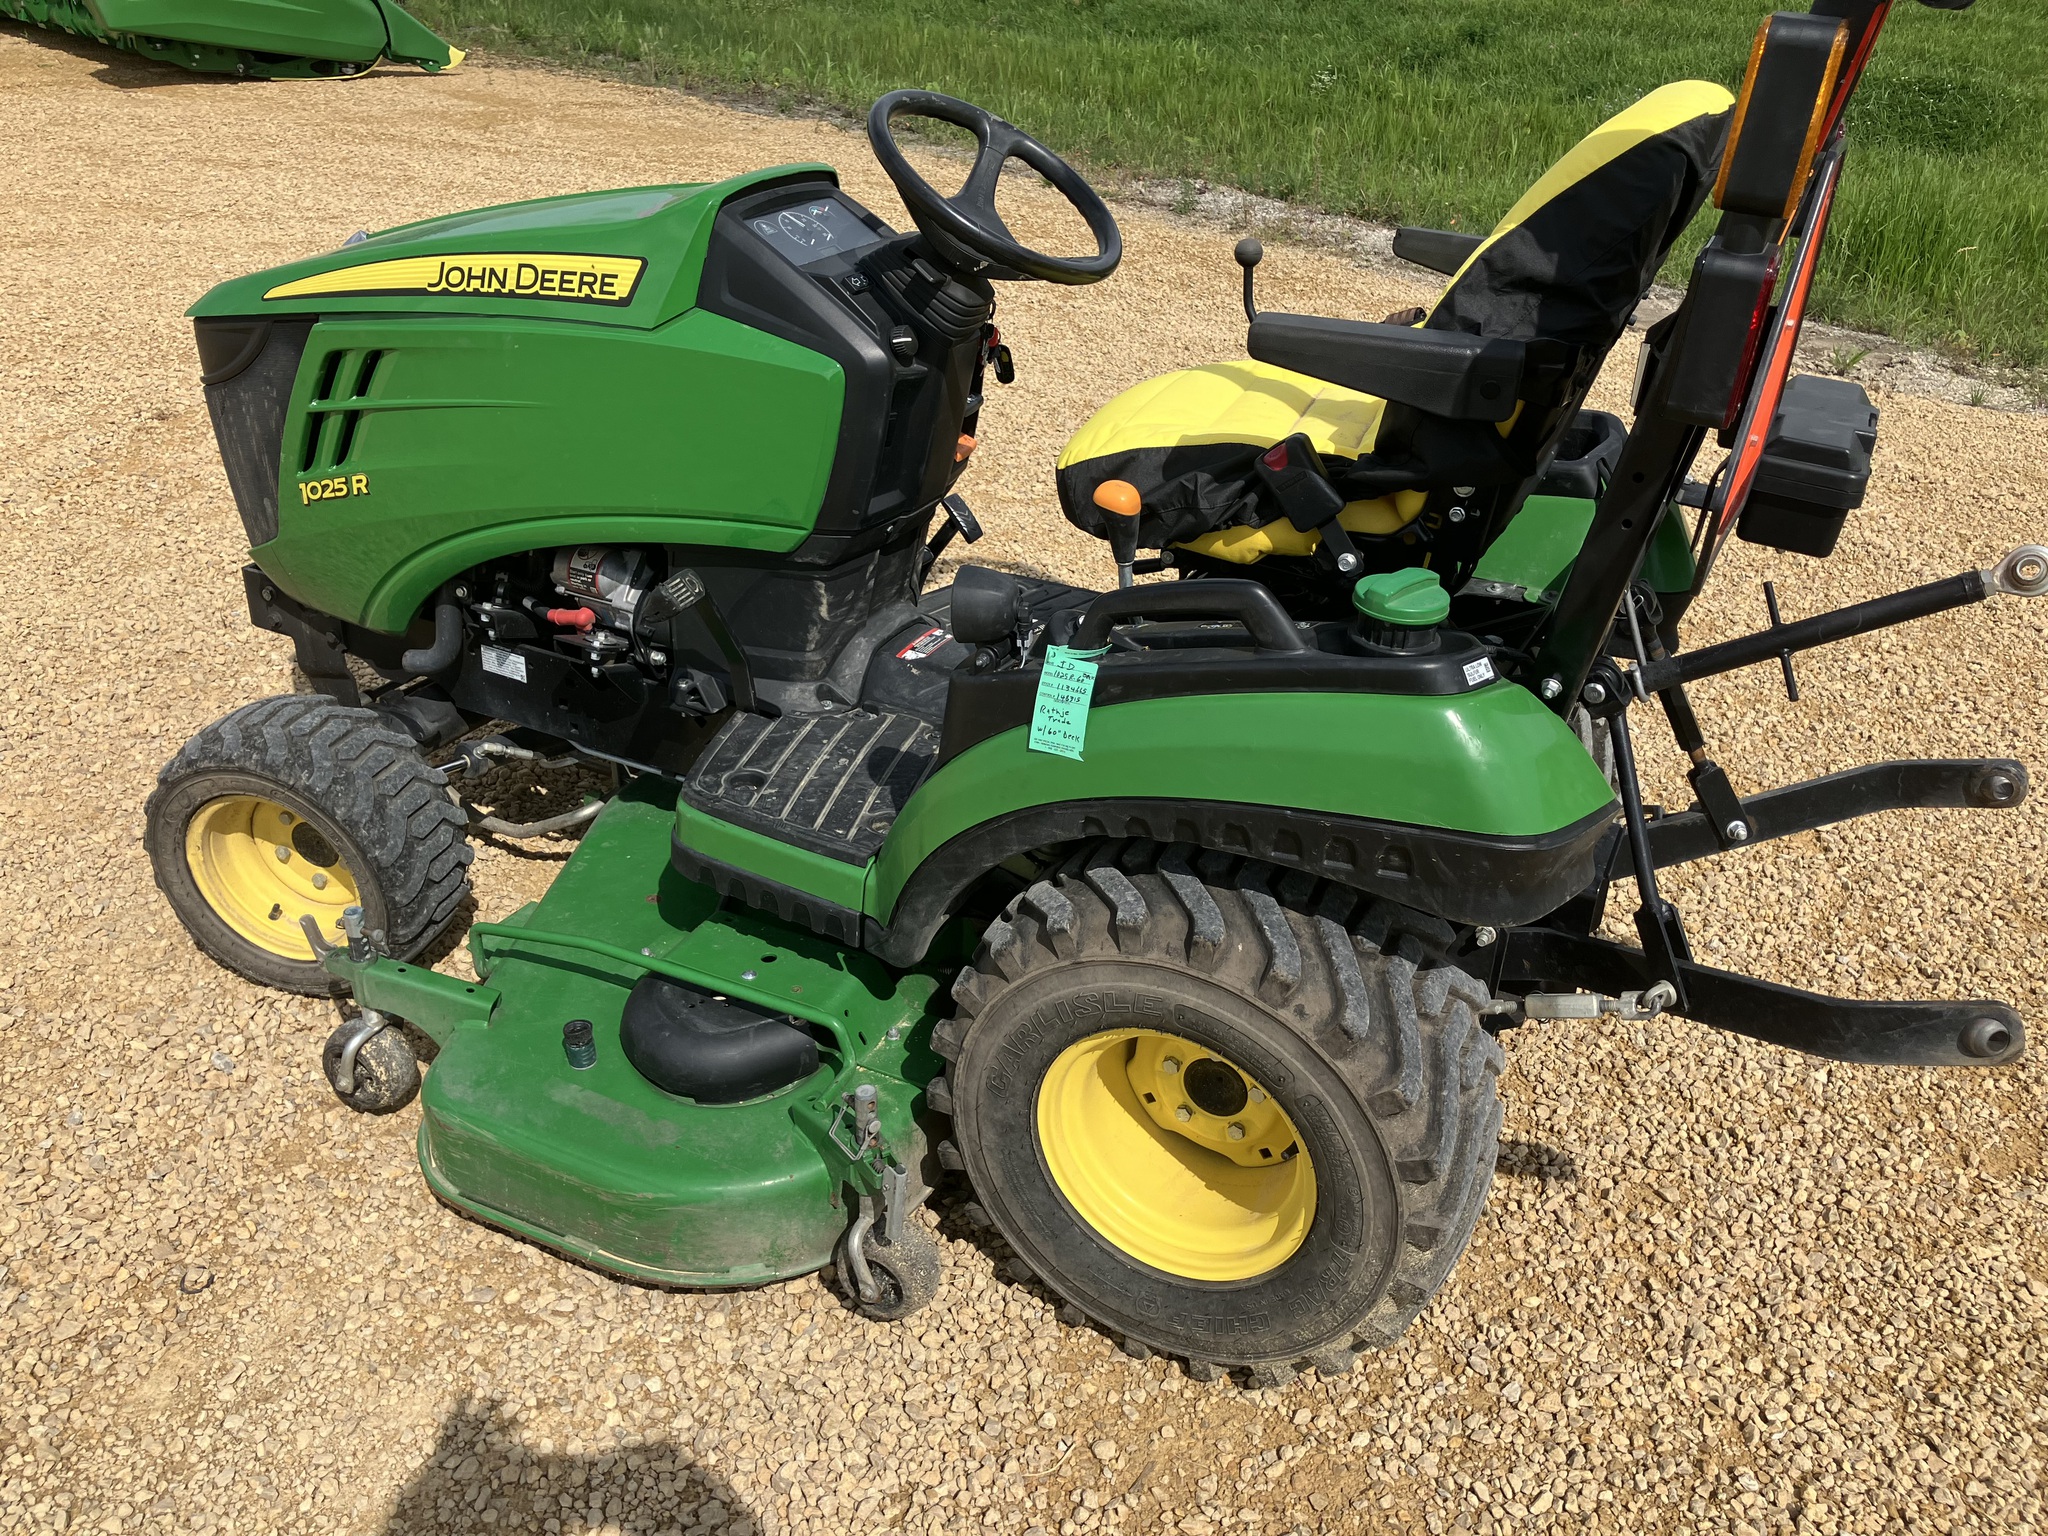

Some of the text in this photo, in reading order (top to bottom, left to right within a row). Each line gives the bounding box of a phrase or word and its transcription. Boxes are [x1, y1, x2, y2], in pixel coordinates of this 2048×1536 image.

[427, 261, 619, 296] JOHN DEERE
[298, 474, 369, 505] 1025 R
[985, 990, 1163, 1098] CARLISLE
[1289, 1252, 1352, 1319] TRAC
[1166, 1311, 1272, 1336] CHIEF
